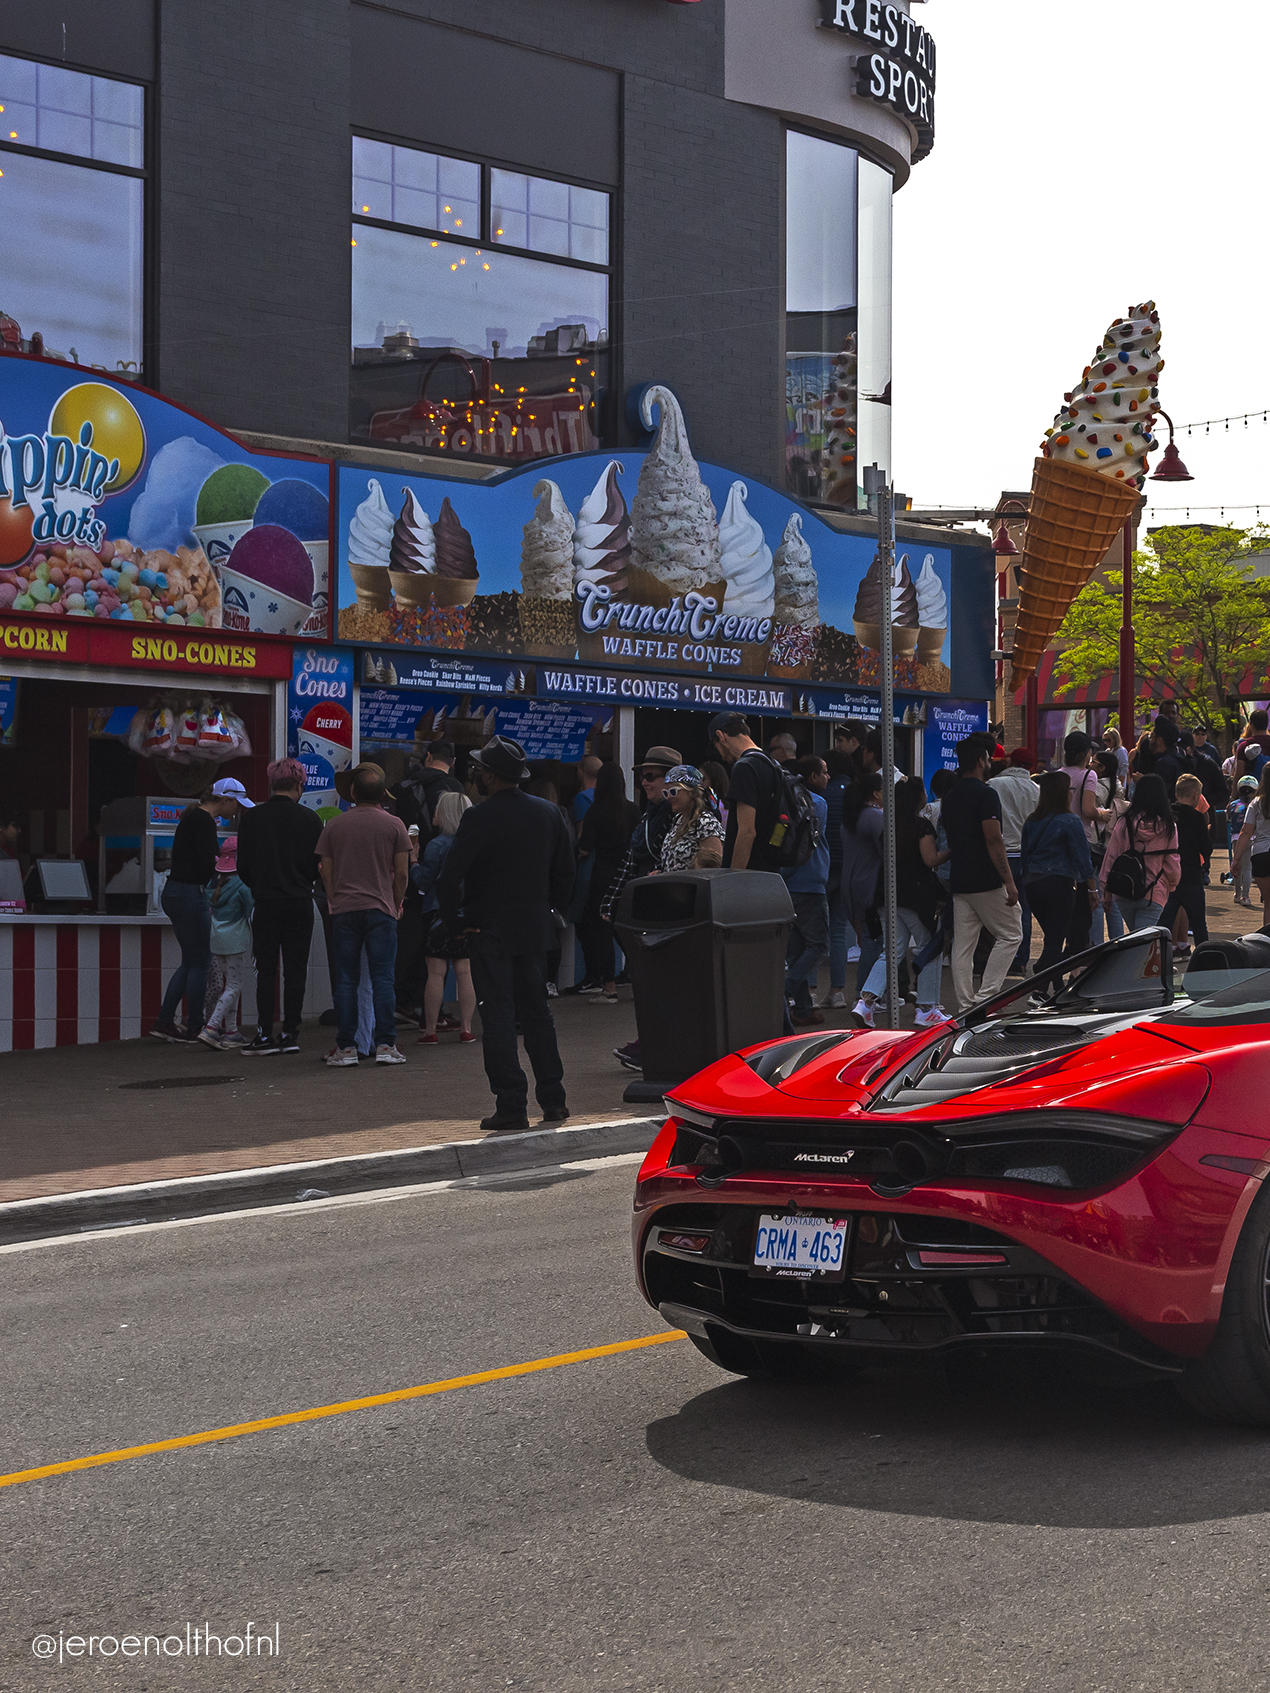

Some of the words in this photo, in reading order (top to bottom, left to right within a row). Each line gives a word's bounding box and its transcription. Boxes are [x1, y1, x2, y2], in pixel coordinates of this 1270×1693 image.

[33, 500, 103, 544] dots
[131, 636, 257, 668] SNO-CONES
[303, 649, 339, 674] Sno
[602, 636, 678, 660] WAFFLE
[682, 644, 742, 666] CONES
[295, 672, 347, 699] Cones
[544, 671, 617, 696] WAFFLE
[621, 678, 679, 700] CONES
[694, 685, 722, 704] ICE
[725, 687, 785, 709] CREAM
[316, 717, 343, 729] CHERRY
[938, 721, 973, 733] WAFFLE
[793, 1151, 853, 1164] McLaren
[784, 1216, 822, 1227] ONTARIO
[756, 1227, 798, 1261] CRMA
[809, 1230, 843, 1264] 463
[776, 1269, 815, 1277] McLaren
